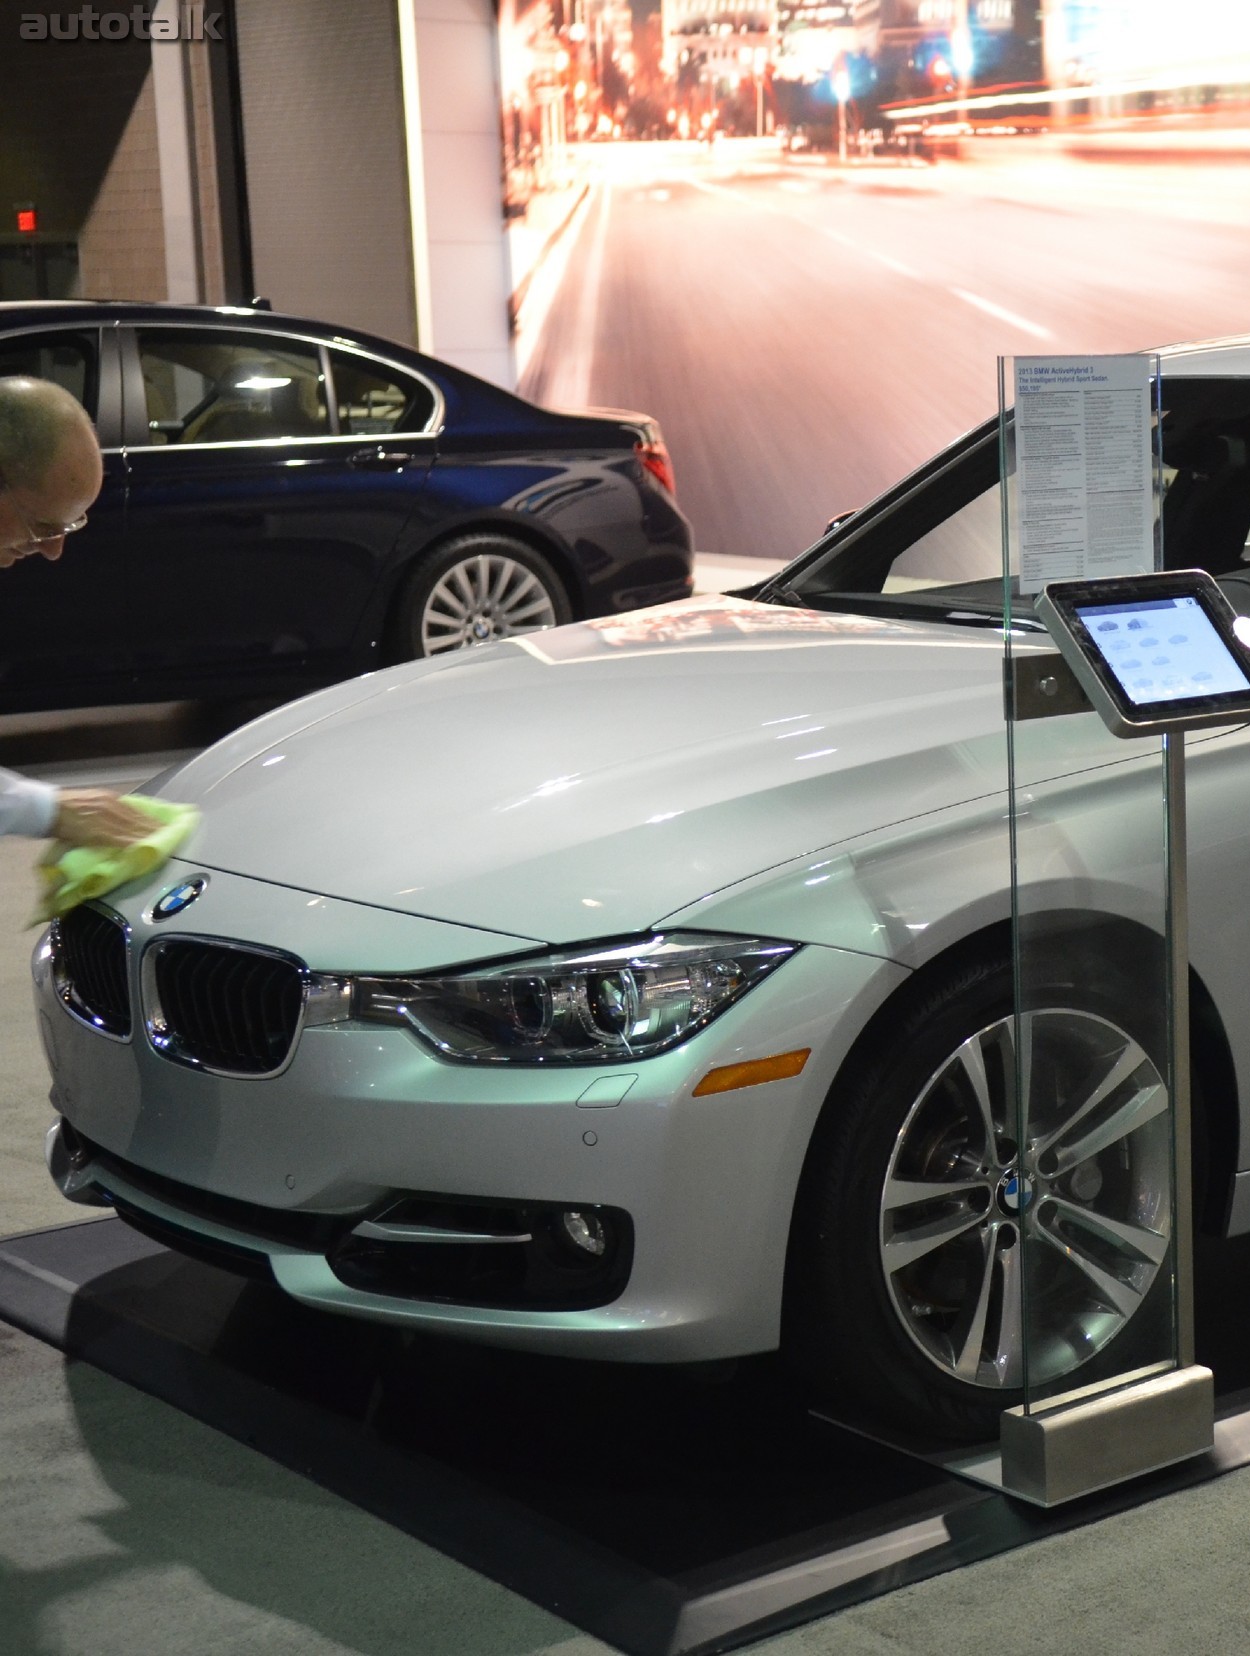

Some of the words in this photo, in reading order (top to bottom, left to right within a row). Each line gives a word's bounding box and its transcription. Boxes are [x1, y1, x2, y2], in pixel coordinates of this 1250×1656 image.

[1034, 367, 1050, 375] BMW
[1051, 366, 1089, 375] ActiveHybrid
[1057, 375, 1075, 383] Hybrid
